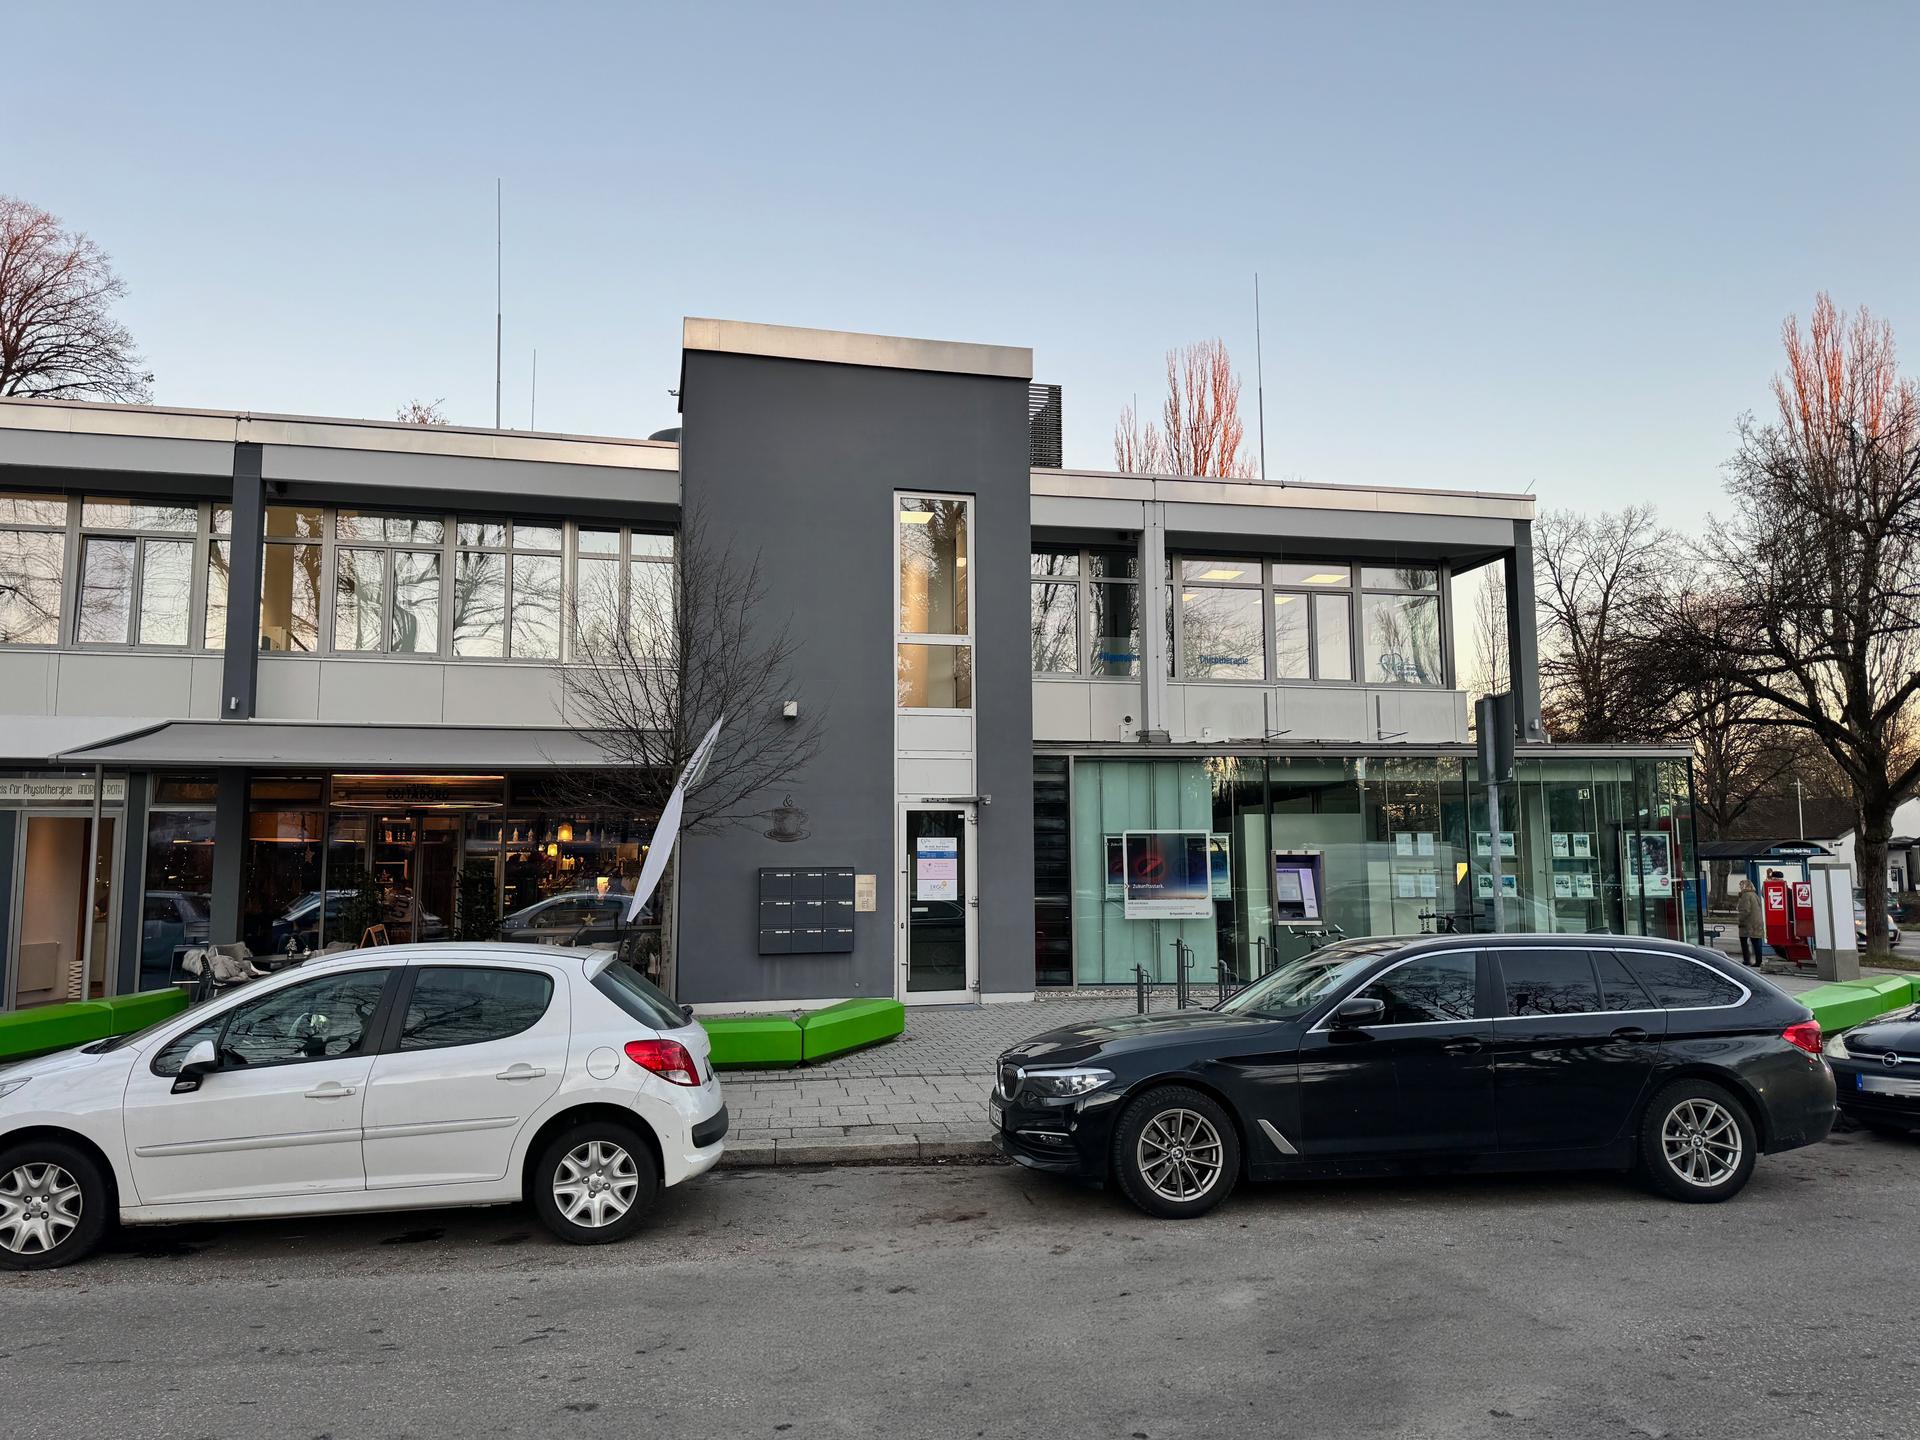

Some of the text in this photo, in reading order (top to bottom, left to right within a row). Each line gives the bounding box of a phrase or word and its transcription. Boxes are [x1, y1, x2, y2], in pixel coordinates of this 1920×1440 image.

[9, 783, 22, 795] für
[23, 783, 73, 797] Physiotherapie
[106, 784, 123, 796] ROTH
